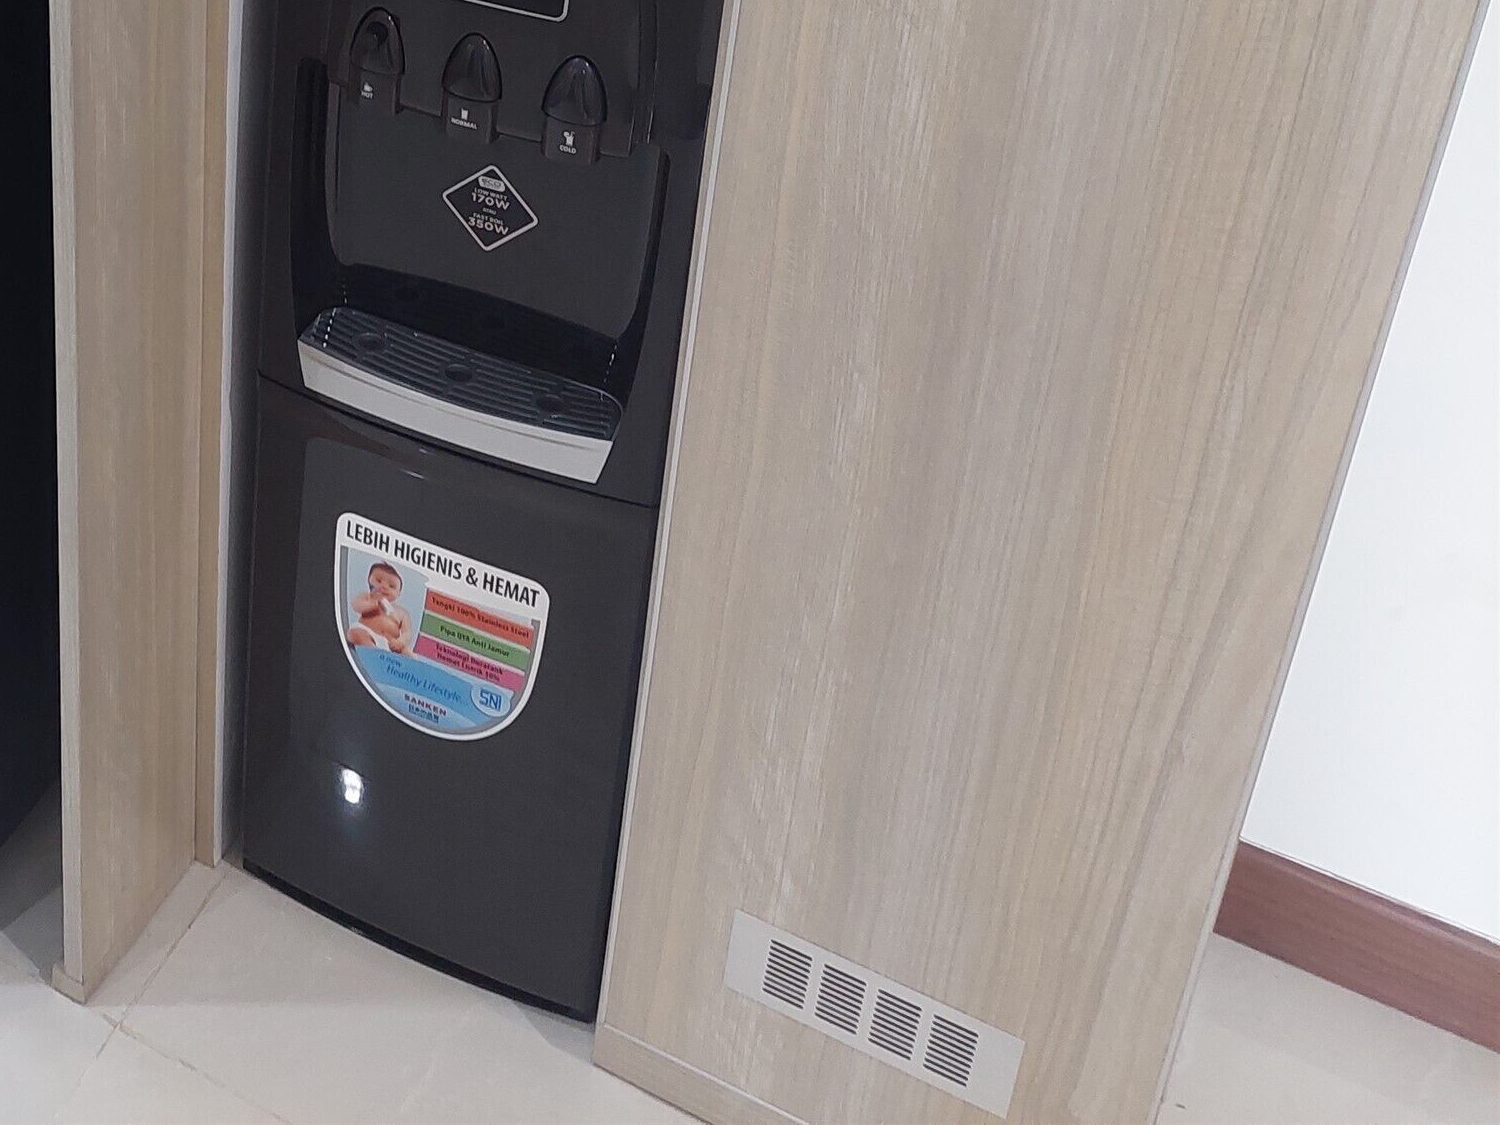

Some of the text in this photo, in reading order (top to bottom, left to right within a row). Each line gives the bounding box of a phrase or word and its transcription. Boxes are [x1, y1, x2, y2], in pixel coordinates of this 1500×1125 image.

[361, 90, 373, 99] HOT
[451, 117, 477, 130] NORMAL
[559, 144, 577, 154] COLD
[471, 192, 510, 210] 170W
[468, 216, 509, 235] 350W
[346, 520, 540, 607] LEBIH HIGIENIS & HEMAT
[387, 665, 421, 687] Healthy
[404, 694, 446, 716] SANKEN
